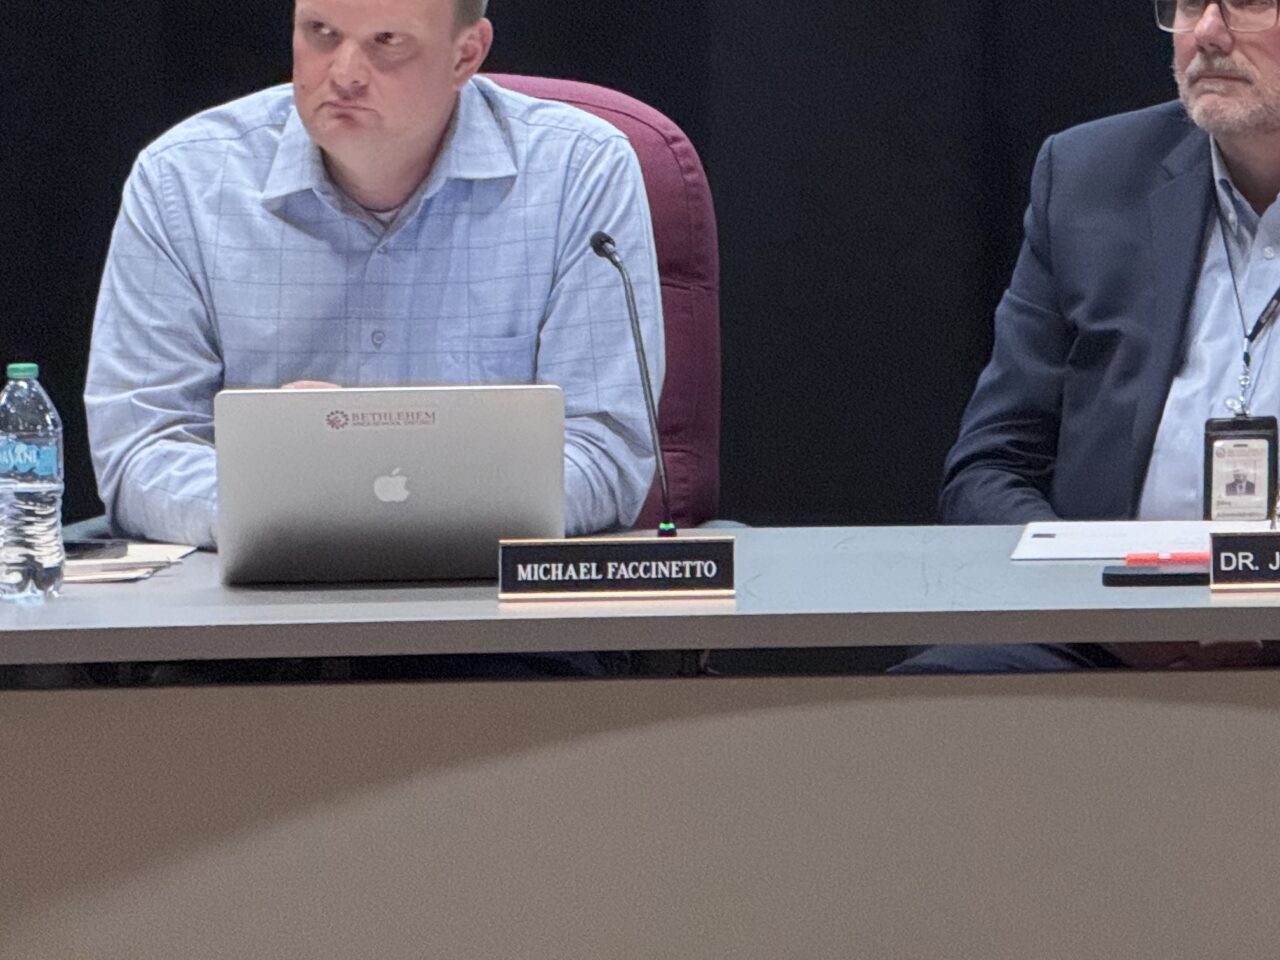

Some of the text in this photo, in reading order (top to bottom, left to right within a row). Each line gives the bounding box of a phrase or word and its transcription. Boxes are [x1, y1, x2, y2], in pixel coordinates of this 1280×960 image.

[351, 411, 436, 422] BETHLEHEM
[517, 560, 718, 581] MICHAEL FACCINETTO
[1220, 552, 1259, 571] DR.
